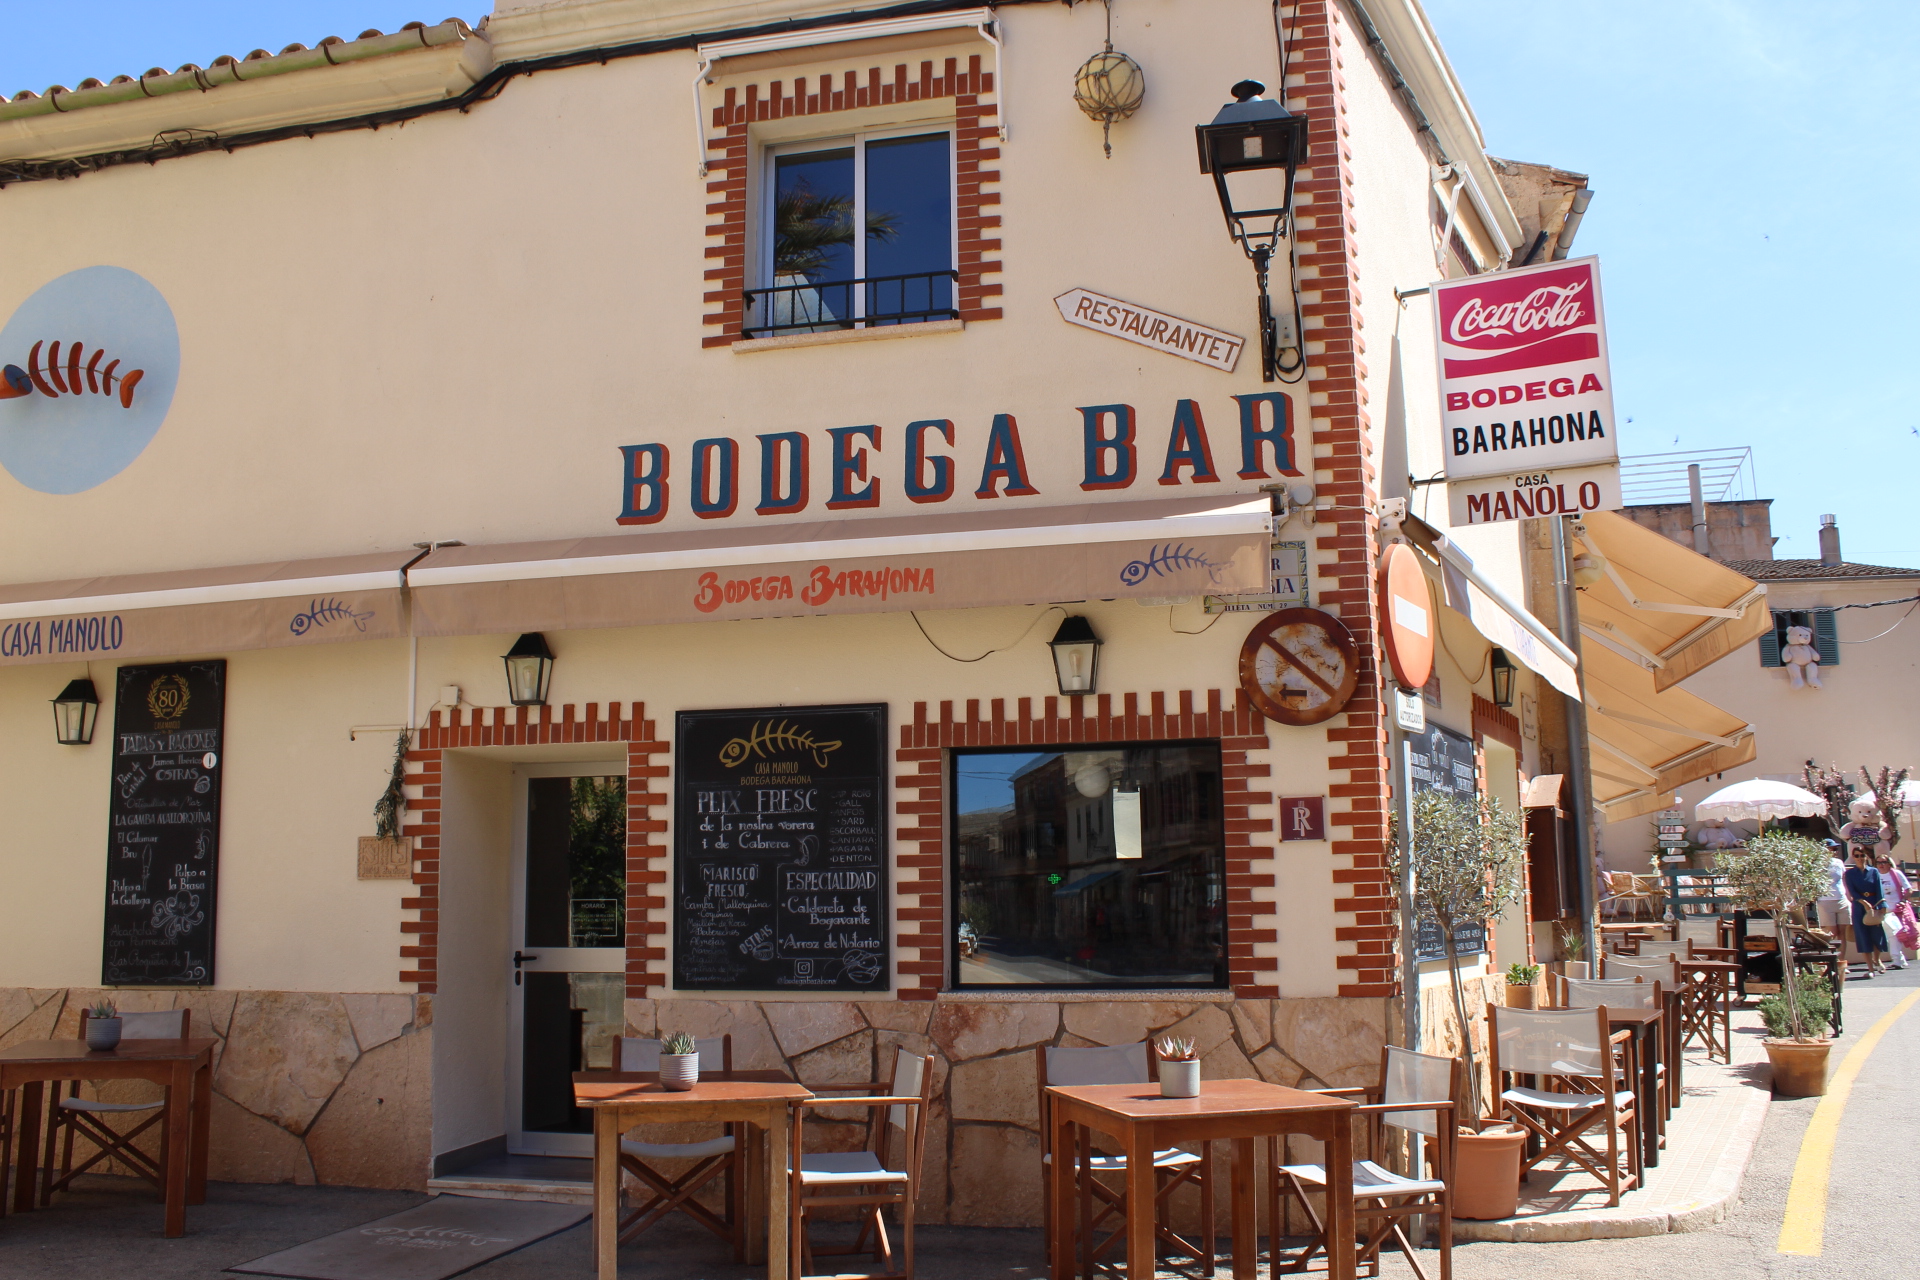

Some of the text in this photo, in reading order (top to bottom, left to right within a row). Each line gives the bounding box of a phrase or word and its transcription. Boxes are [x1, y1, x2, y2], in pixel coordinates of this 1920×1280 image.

[1450, 278, 1588, 342] Coca-Cola
[1075, 296, 1240, 364] RESTAURANTET
[1446, 373, 1603, 412] BODEGA
[1452, 410, 1605, 456] BARAHONA
[616, 391, 1305, 526] BODEGA BAR
[1515, 474, 1550, 488] CASA
[1467, 480, 1600, 524] MANOLO
[1, 615, 123, 657] CASA MANOLO
[158, 689, 178, 708] 80
[120, 734, 156, 753] TAPAS
[168, 732, 216, 751] RACIONES
[116, 761, 141, 786] Pan de
[155, 767, 199, 781] OSTRAS
[755, 761, 799, 774] CASA MANOLO
[740, 775, 812, 786] BODEGA BARAHONA
[169, 798, 178, 807] de
[697, 788, 818, 813] PEIX FRESC
[839, 799, 862, 807] GALL
[115, 809, 212, 826] LA GAMBA MALLORQUINA
[699, 813, 816, 831] de la nostra vorera
[841, 816, 865, 825] SARD
[118, 831, 159, 843] El Calamar
[829, 827, 876, 835] ESCORBALL
[702, 832, 790, 849] i de Cabrera
[122, 846, 138, 859] Bru
[832, 854, 872, 863] DENTON
[175, 863, 206, 882] Pulpo a
[703, 867, 756, 881] MARISCO
[786, 871, 876, 890] ESPECIALIDAD
[112, 878, 134, 894] Pulpo
[168, 878, 205, 891] la Brasa
[708, 883, 745, 897] FRESCO
[111, 893, 151, 909] la Gallega
[684, 896, 715, 910] Gamba
[787, 895, 868, 913] Caldereta de
[809, 912, 871, 931] Bogavante
[109, 939, 124, 948] con
[739, 924, 774, 955] OSTRAS
[783, 931, 881, 949] Arroz de Notario
[171, 952, 181, 967] de
